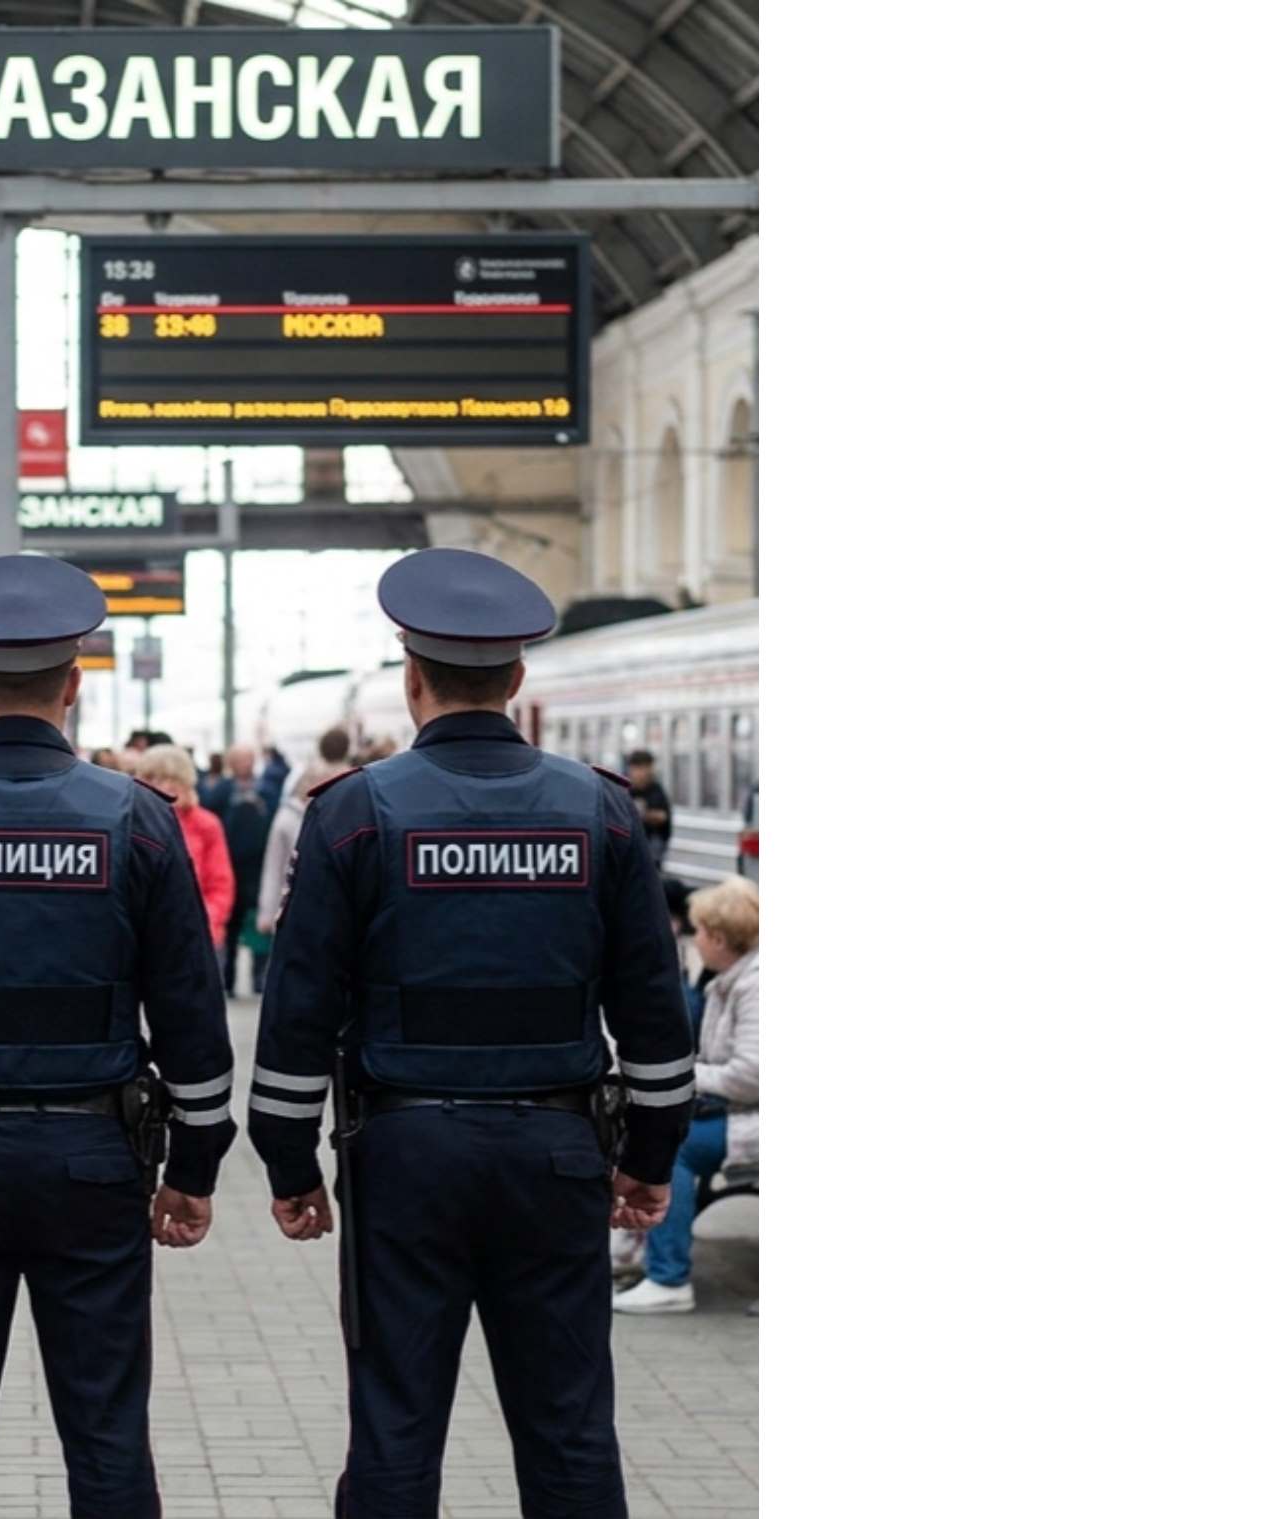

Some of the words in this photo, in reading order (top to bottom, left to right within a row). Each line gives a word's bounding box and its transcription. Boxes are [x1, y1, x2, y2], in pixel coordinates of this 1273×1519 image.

[282, 313, 385, 338] МОСКВА
[17, 496, 164, 528] ЗАНСКАЯ
[417, 843, 579, 881] ПОЛИЦИЯ
